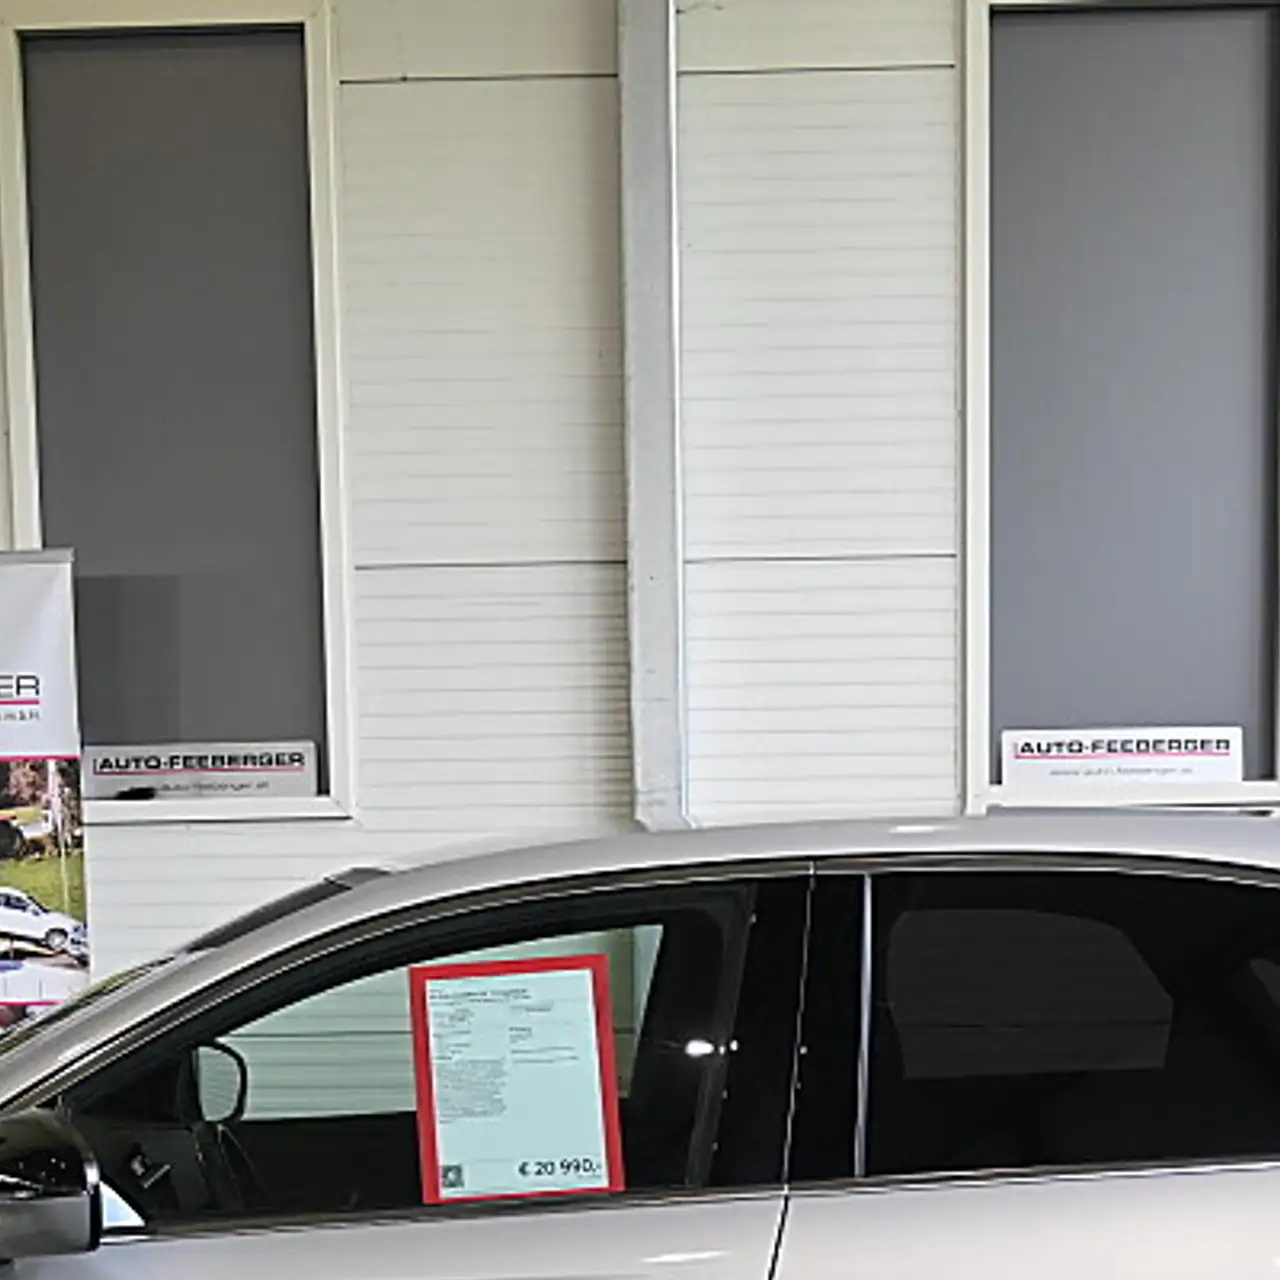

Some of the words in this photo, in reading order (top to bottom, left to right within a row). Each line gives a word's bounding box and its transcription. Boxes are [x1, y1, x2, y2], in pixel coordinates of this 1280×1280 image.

[1020, 739, 1231, 755] AUTO-FEEBERGER
[99, 751, 305, 770] AUTO-FEEBERGER
[534, 1161, 554, 1176] 20
